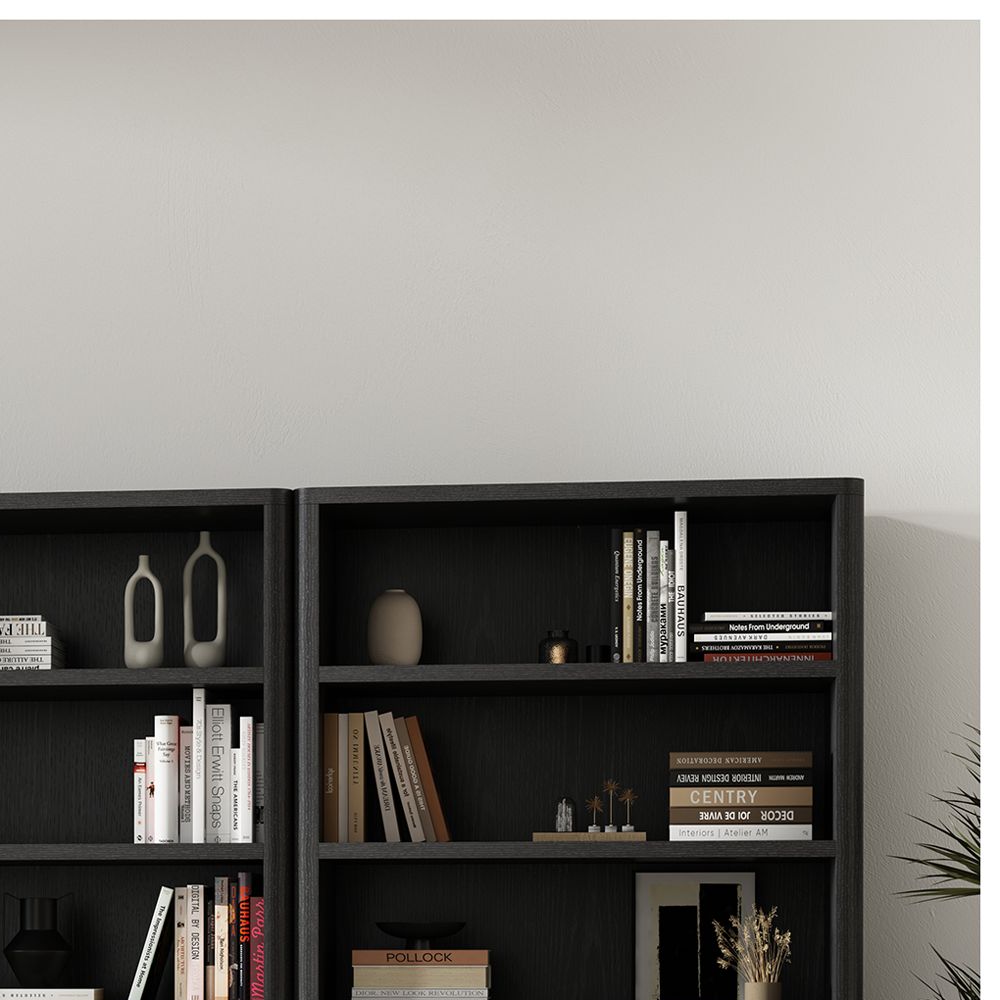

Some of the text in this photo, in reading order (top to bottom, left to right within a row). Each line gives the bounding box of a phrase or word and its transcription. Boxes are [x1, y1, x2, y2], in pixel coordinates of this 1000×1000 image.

[624, 537, 633, 598] EUGENE ONEGIN
[636, 539, 644, 583] Underground
[17, 624, 45, 636] THE
[660, 604, 668, 655] мураками
[677, 585, 685, 637] BAUHAUS
[729, 622, 810, 632] Notes From Underground
[209, 708, 225, 829] Elliott Erwitt Snaps
[732, 774, 762, 783] INTERIOR
[690, 790, 758, 804] CENTRY
[699, 810, 794, 821] DECOR JOI DE VIVRE
[678, 829, 768, 837] Interiors Atelier AM
[191, 885, 199, 960] DIGITAL BY DESIGN
[136, 905, 166, 988] The Impressionists at Home
[386, 952, 452, 963] POLLOCK
[251, 942, 264, 1000] Martin
